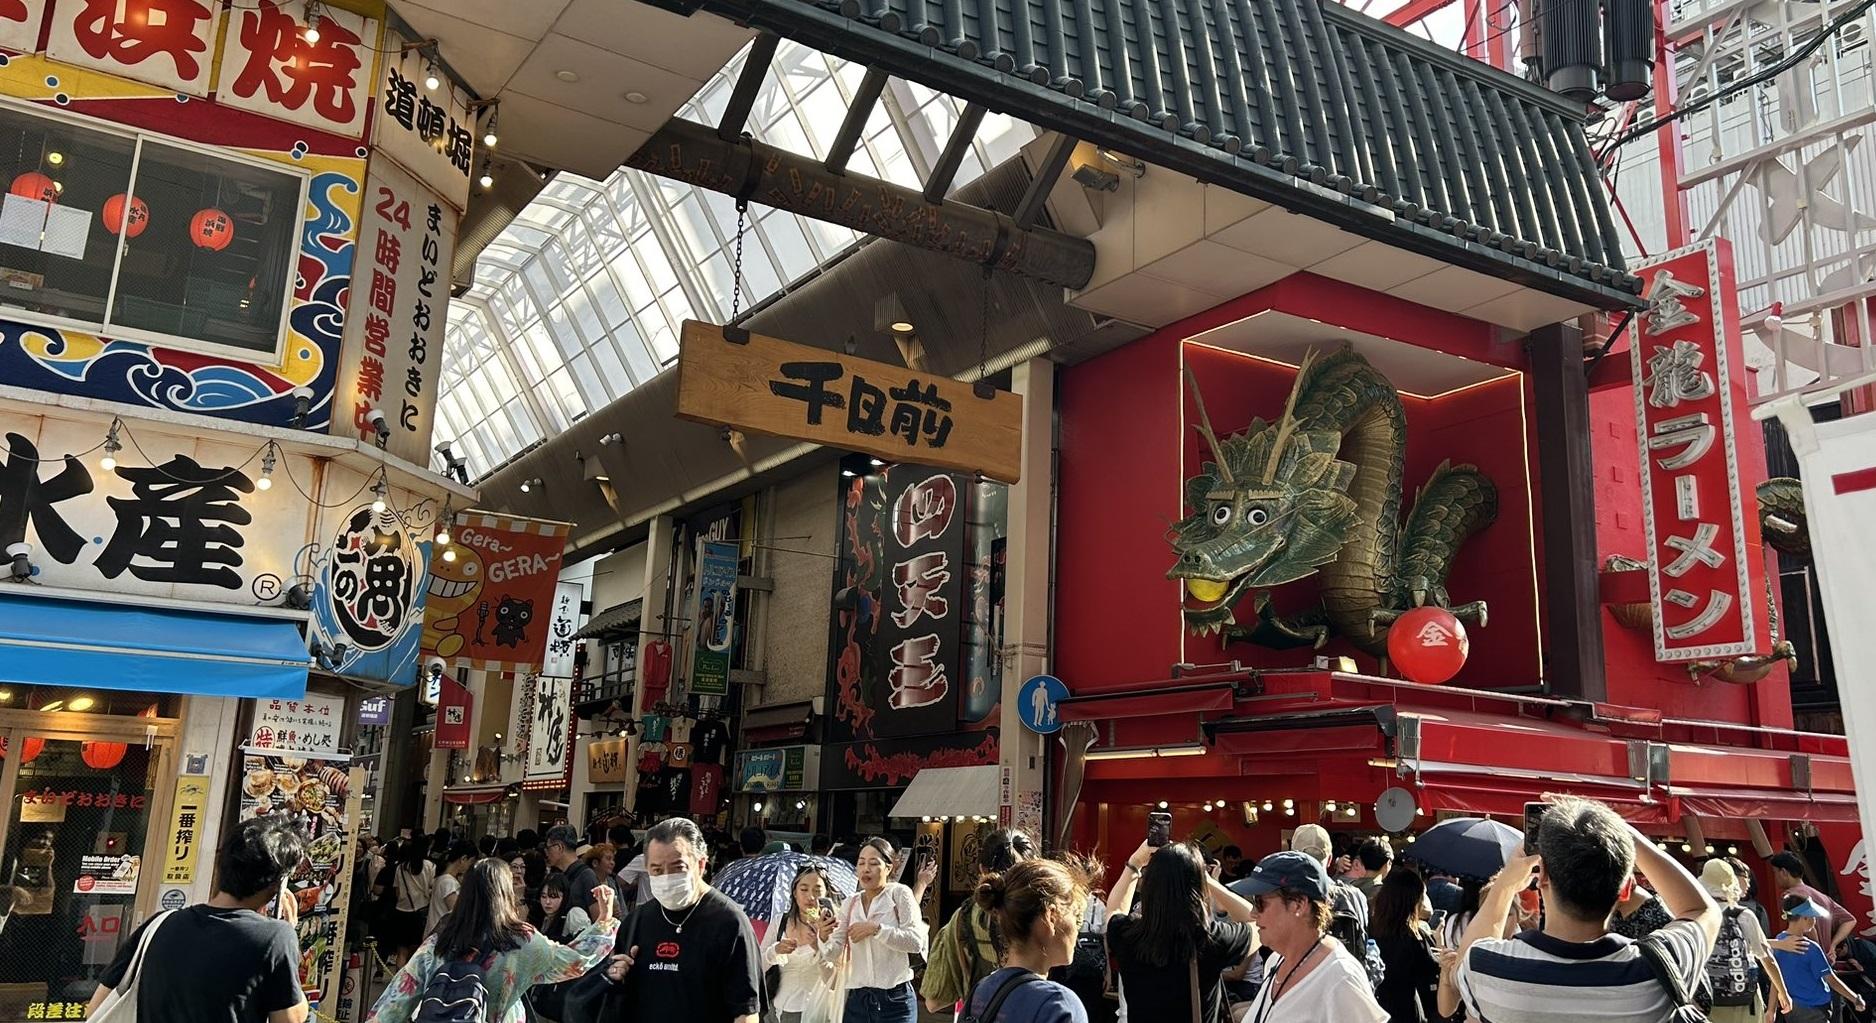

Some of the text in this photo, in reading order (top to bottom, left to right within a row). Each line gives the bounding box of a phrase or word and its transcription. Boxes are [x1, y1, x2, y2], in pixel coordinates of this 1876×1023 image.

[0, 0, 365, 124] 浜焼
[385, 67, 472, 177] 道頓堀
[400, 203, 442, 432] まいどおおきに
[769, 360, 953, 448] 千日前
[1642, 268, 1733, 640] 金龍ラーメン
[1416, 620, 1453, 647] 金
[174, 804, 198, 861] 一番搾り
[1728, 938, 1746, 993] adidas
[27, 1002, 87, 1020] 段差注
